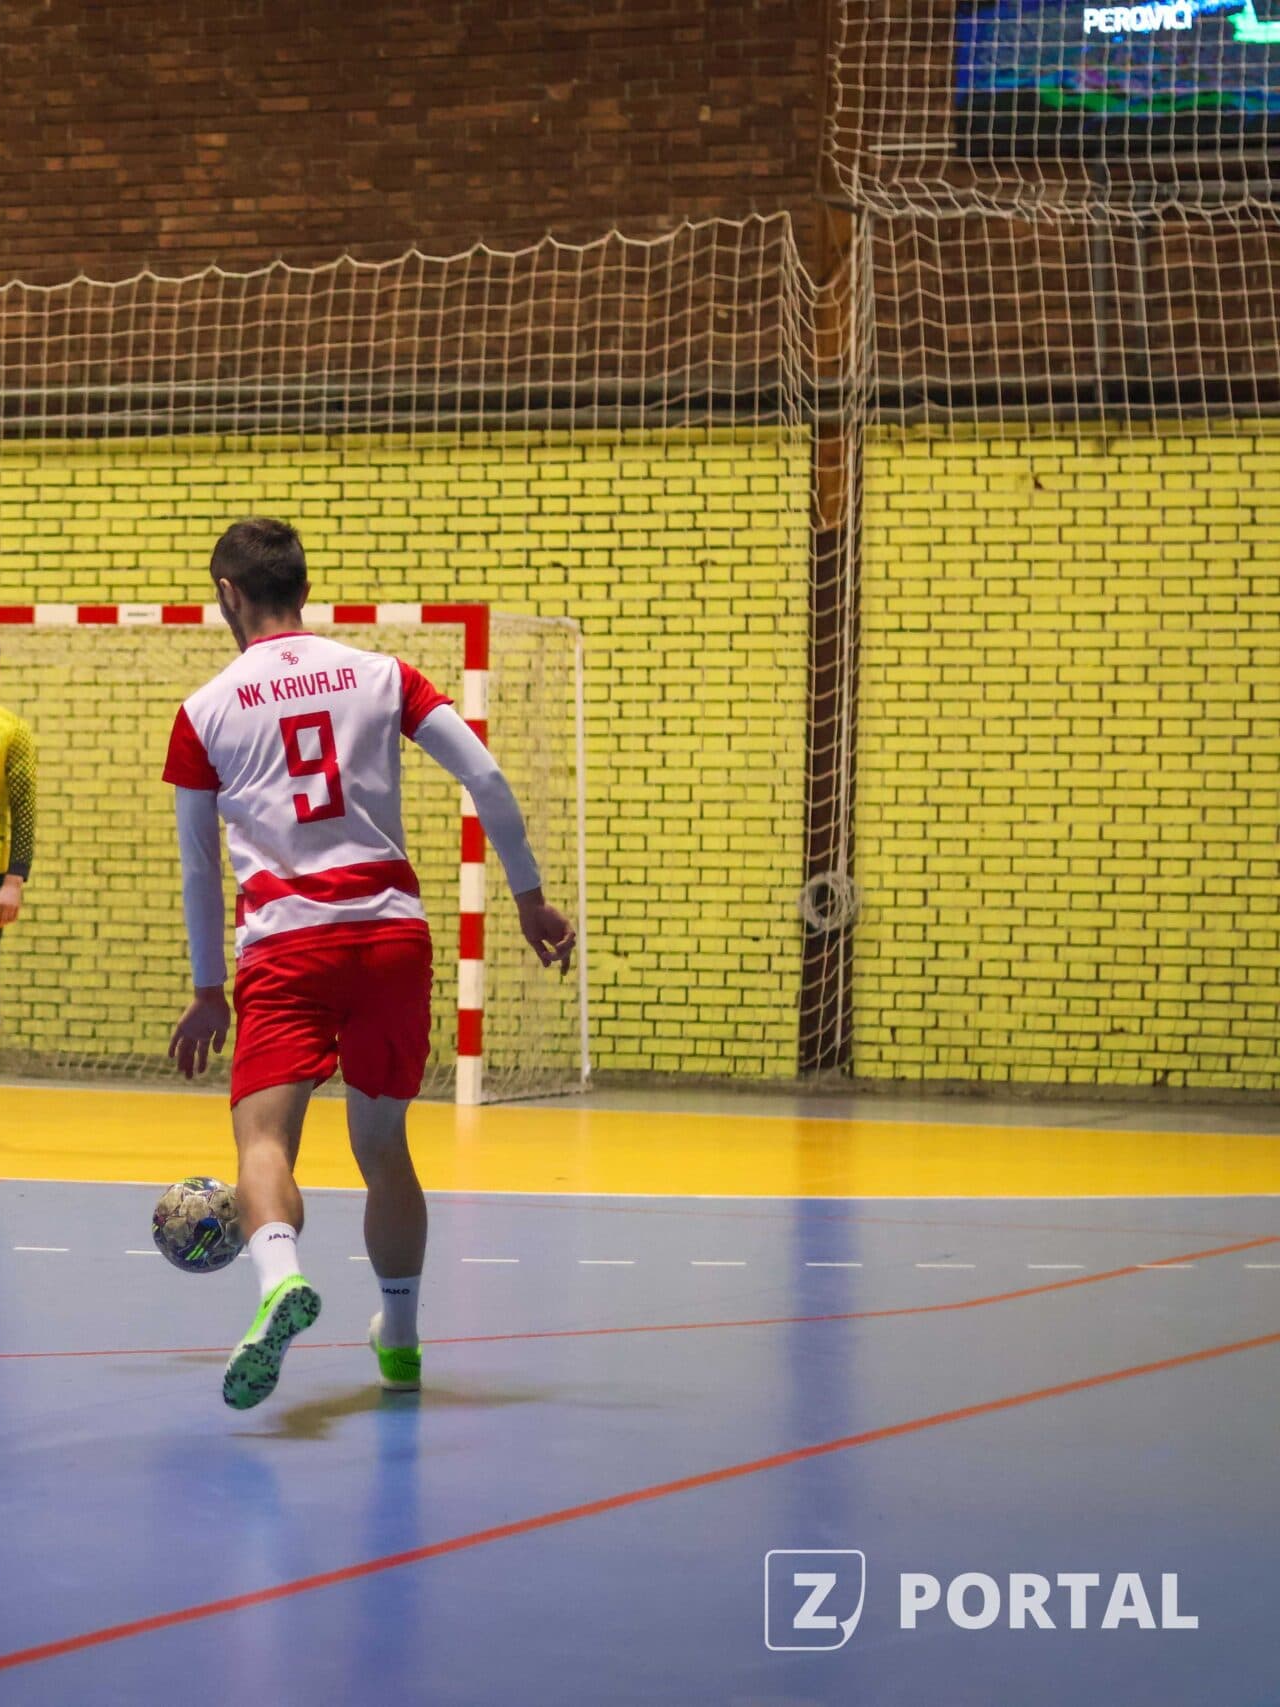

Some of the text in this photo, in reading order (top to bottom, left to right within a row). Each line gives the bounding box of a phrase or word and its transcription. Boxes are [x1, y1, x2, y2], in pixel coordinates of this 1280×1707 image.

[237, 668, 358, 710] NK KRIVAJA
[279, 710, 346, 824] 9
